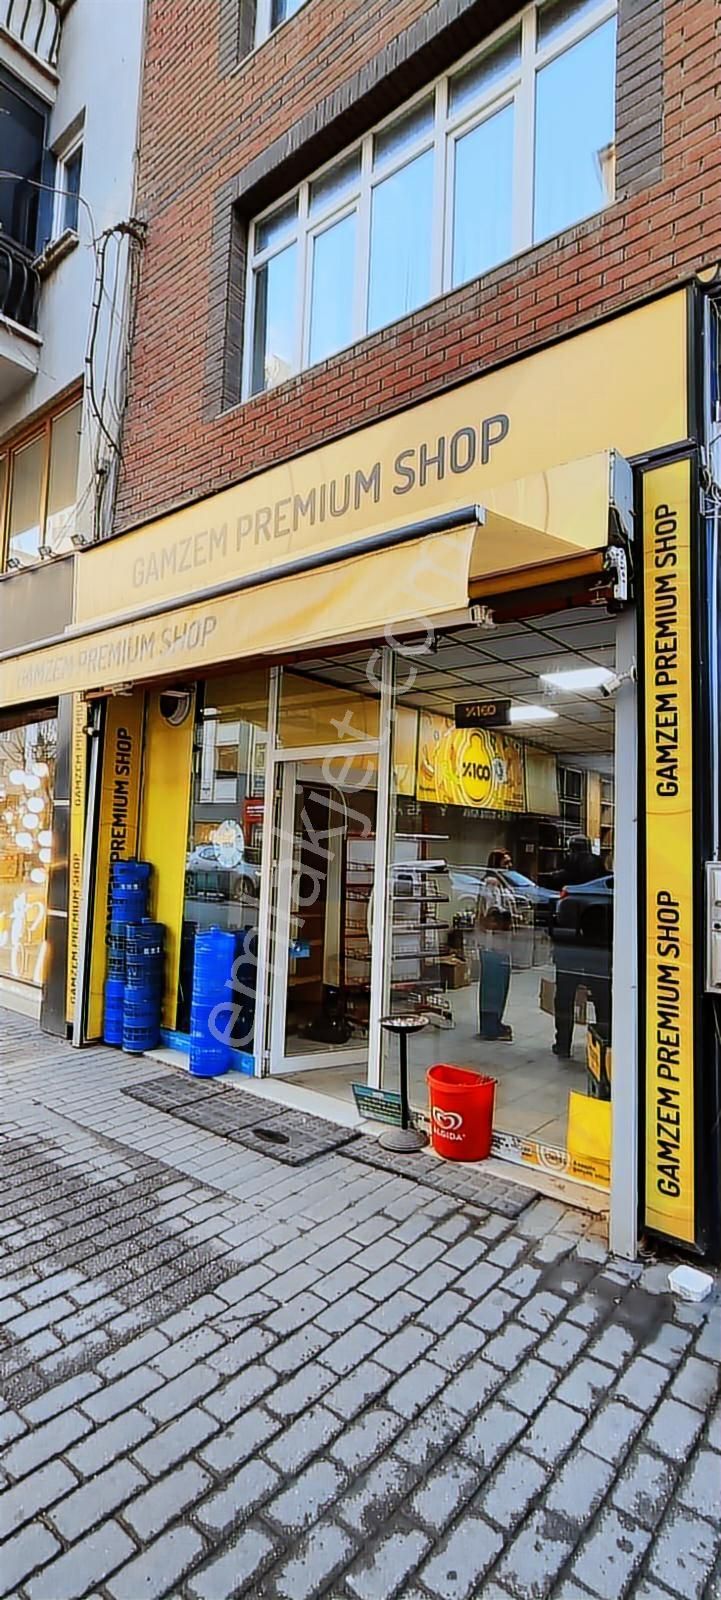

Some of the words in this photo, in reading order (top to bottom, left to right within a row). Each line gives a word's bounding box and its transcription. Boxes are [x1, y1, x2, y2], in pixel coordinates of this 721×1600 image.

[131, 522, 228, 590] GAMZEM
[236, 461, 382, 553] PREMIUM
[392, 413, 510, 496] SHOP
[654, 502, 678, 569] SHOP
[79, 631, 156, 674] PREMIUM
[160, 615, 218, 655] SHOP
[654, 575, 678, 693] PREMIUM
[115, 727, 132, 776] SHOP
[462, 762, 491, 782] %100
[655, 695, 679, 798] GAMZEM
[110, 779, 130, 863] PREMIUM
[72, 853, 82, 886] SHOP
[71, 889, 81, 948] PREMIUM
[657, 890, 680, 960] SHOP
[657, 964, 680, 1083] PREMIUM
[657, 1088, 681, 1198] GAMZEM
